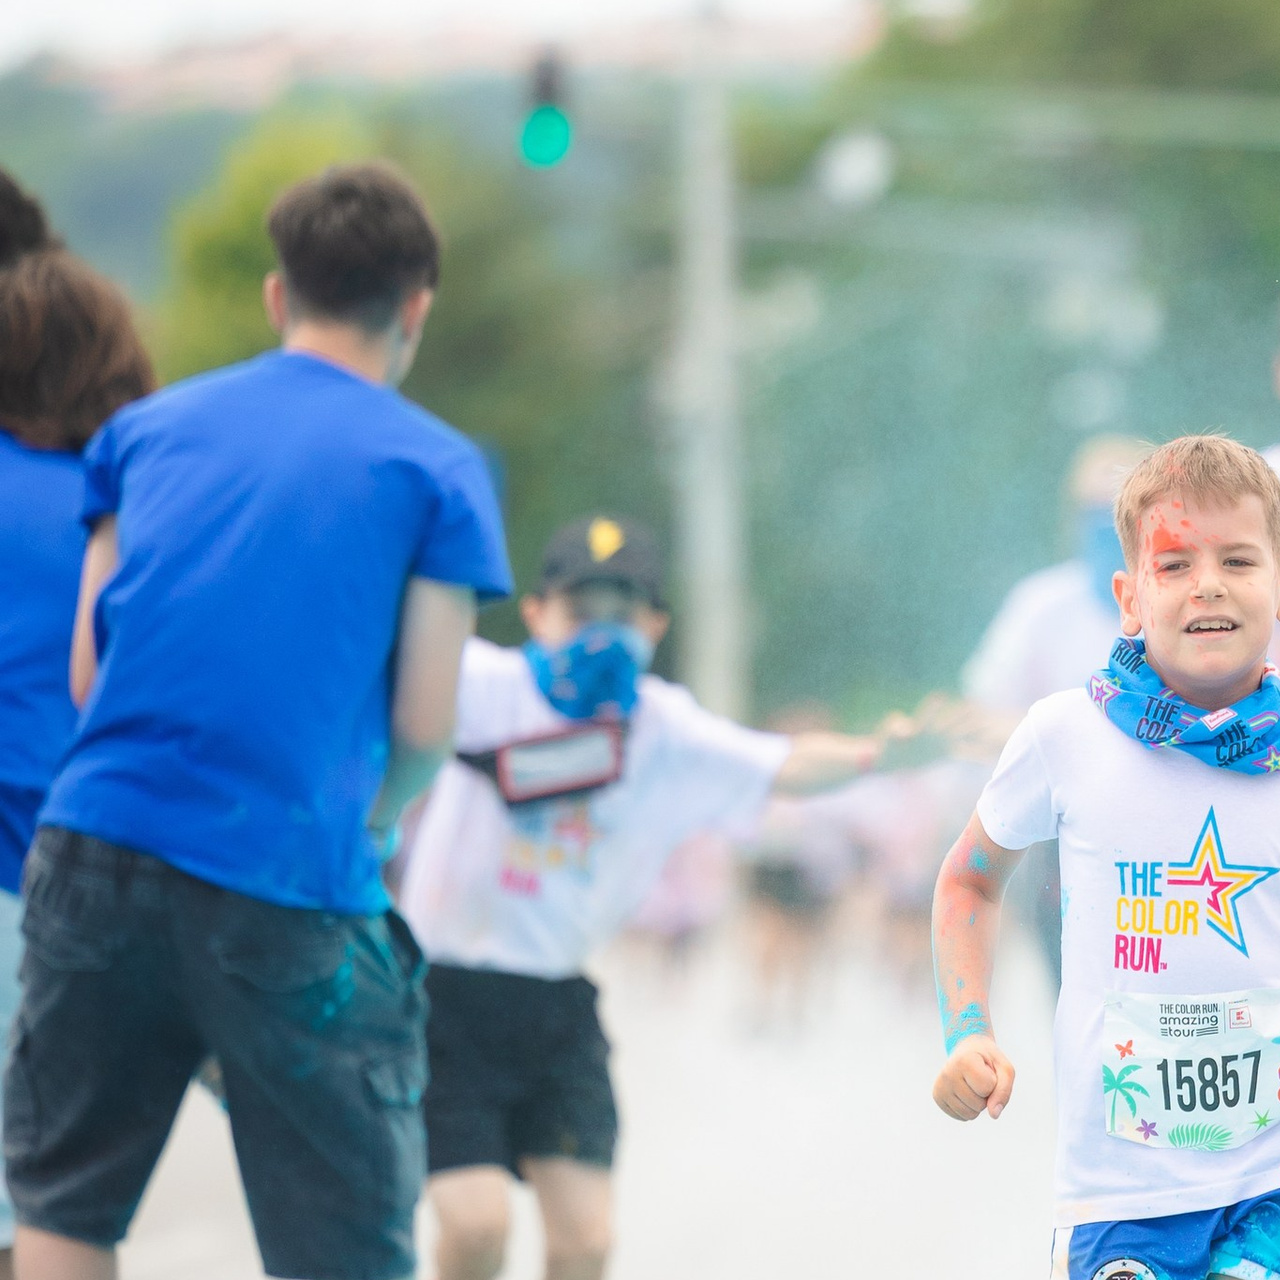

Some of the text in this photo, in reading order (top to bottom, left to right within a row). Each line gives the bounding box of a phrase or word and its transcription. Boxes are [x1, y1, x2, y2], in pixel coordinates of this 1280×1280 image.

[1145, 695, 1180, 724] THE
[1219, 719, 1250, 747] THE
[1114, 861, 1163, 897] THE
[1116, 897, 1199, 936] COLOR
[1159, 1002, 1174, 1014] THE
[1175, 1002, 1201, 1015] COLOR
[1159, 1014, 1219, 1026] amazing
[1168, 1026, 1195, 1037] tour
[1156, 1049, 1262, 1113] 15857
